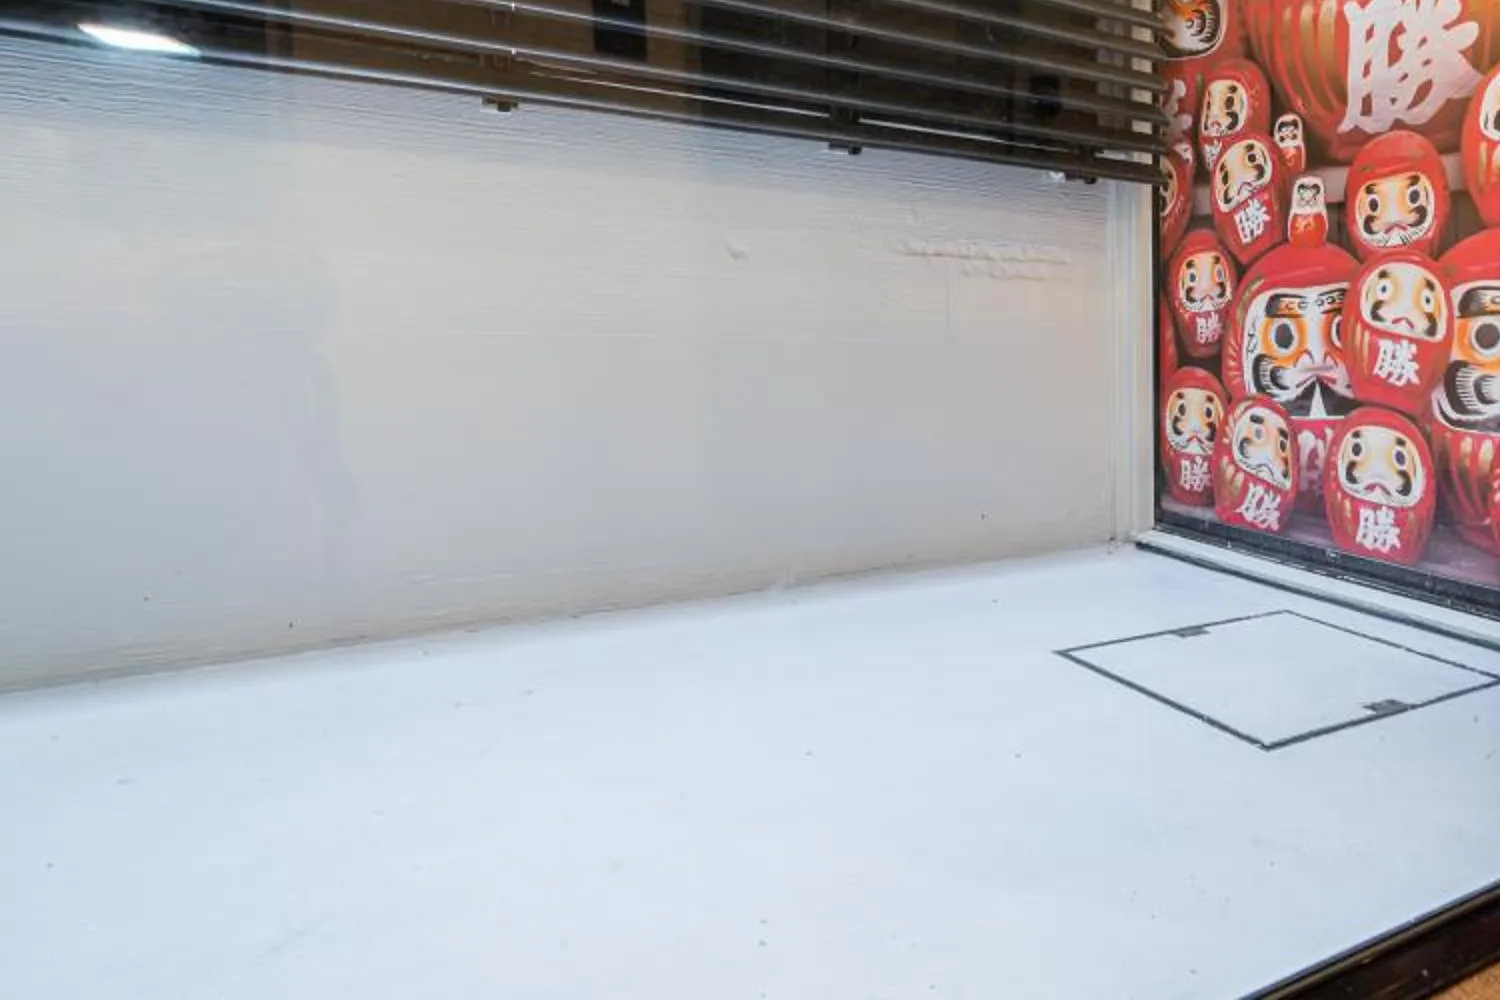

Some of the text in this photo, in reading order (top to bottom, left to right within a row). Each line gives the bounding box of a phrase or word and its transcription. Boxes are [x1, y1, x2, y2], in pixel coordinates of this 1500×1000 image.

[1234, 198, 1271, 243] 勝
[1373, 338, 1421, 387] 勝
[1179, 455, 1211, 493] 勝
[1234, 482, 1281, 531] 勝
[1355, 505, 1401, 554] 勝
